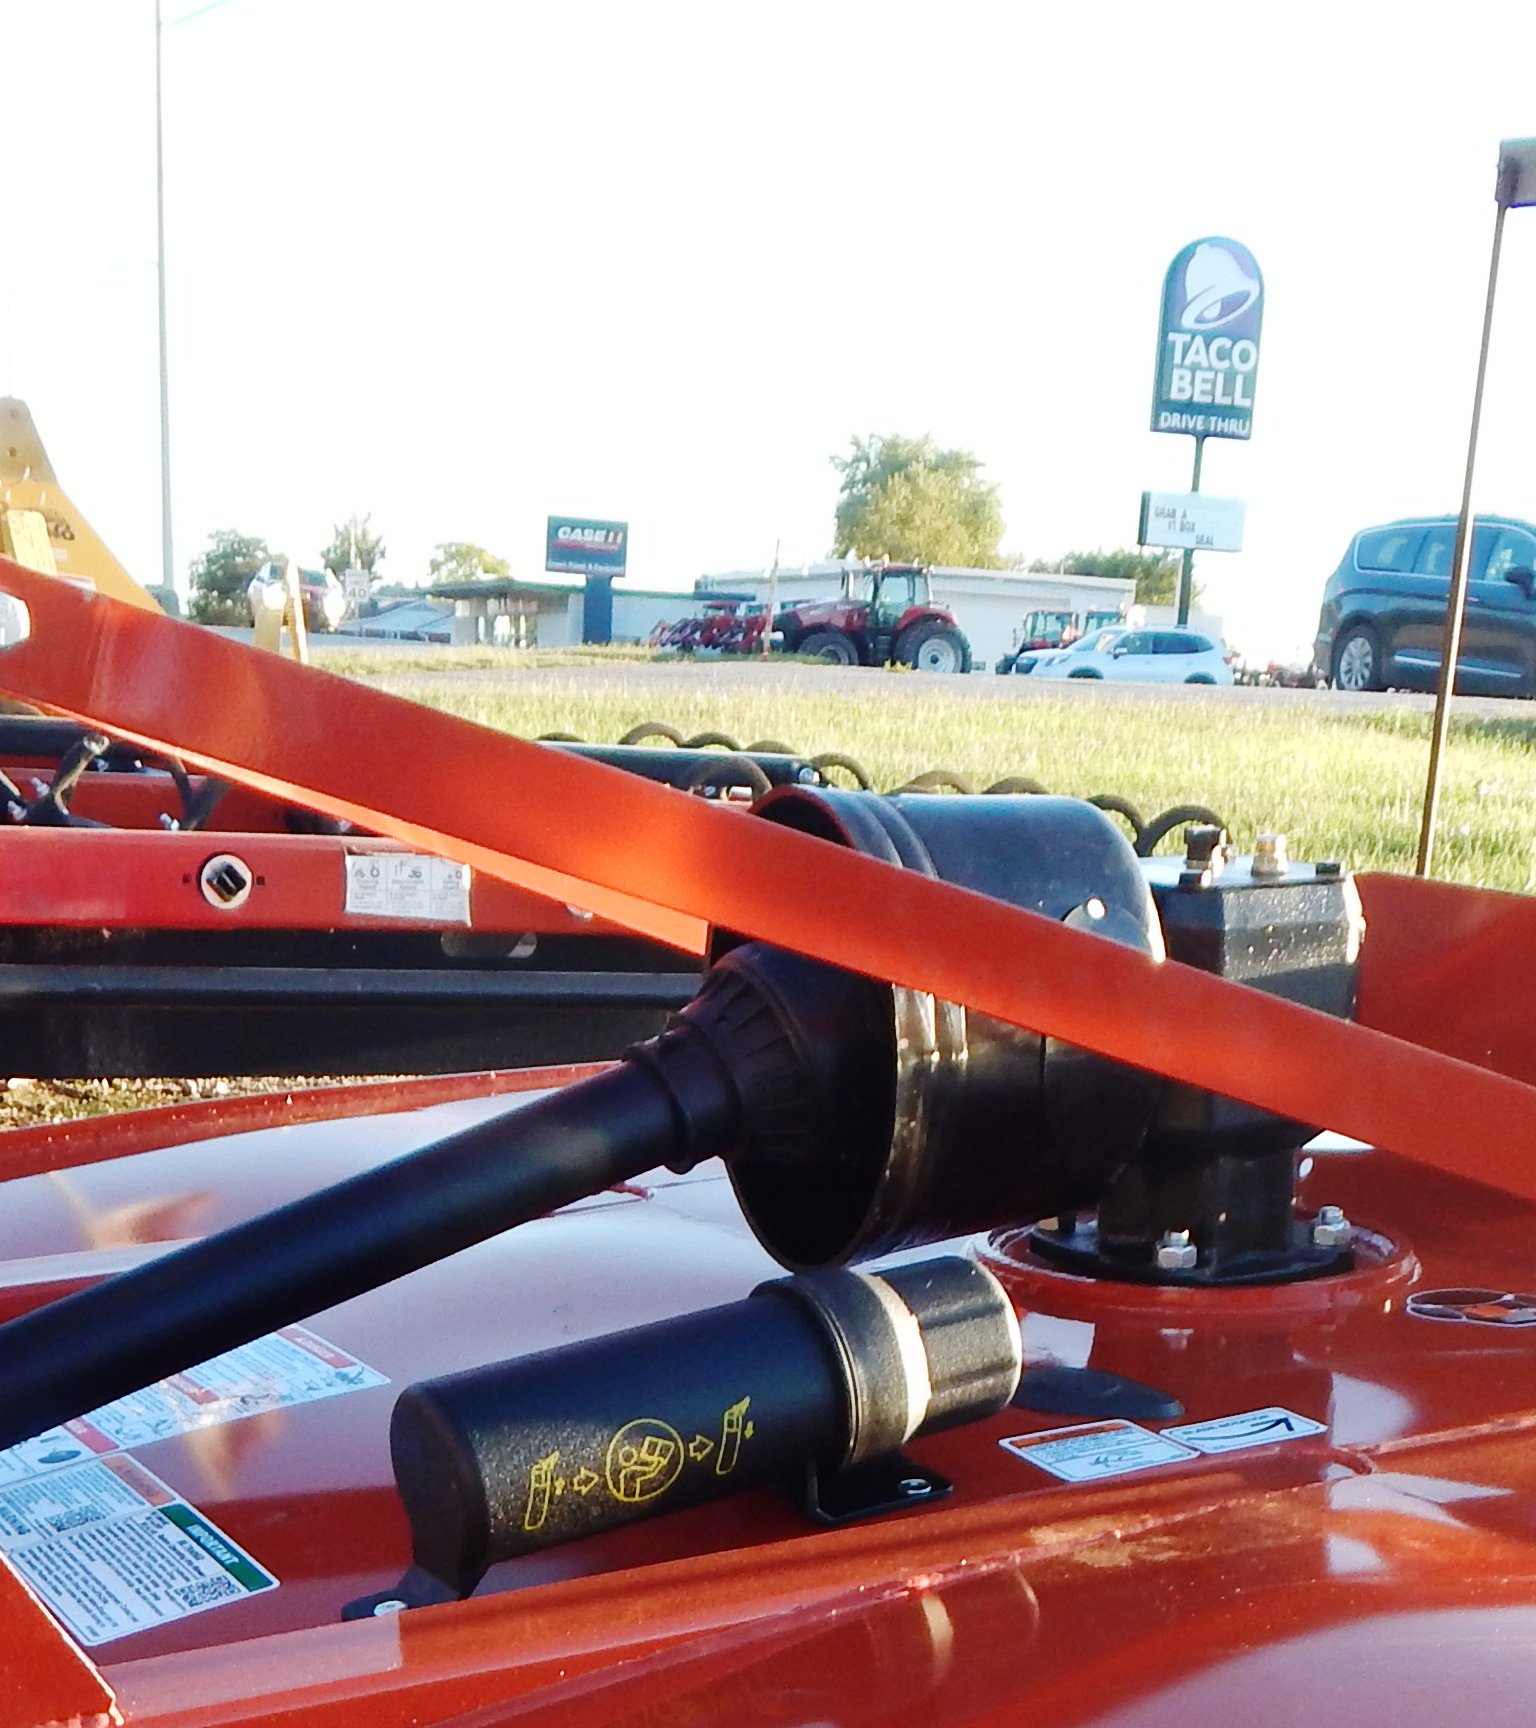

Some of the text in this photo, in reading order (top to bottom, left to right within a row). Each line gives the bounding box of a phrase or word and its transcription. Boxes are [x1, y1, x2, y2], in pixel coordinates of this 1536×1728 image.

[1167, 332, 1257, 372] TACO
[1170, 367, 1252, 407] BELL
[1160, 411, 1250, 434] DRIVE THRU
[557, 526, 607, 542] CASE
